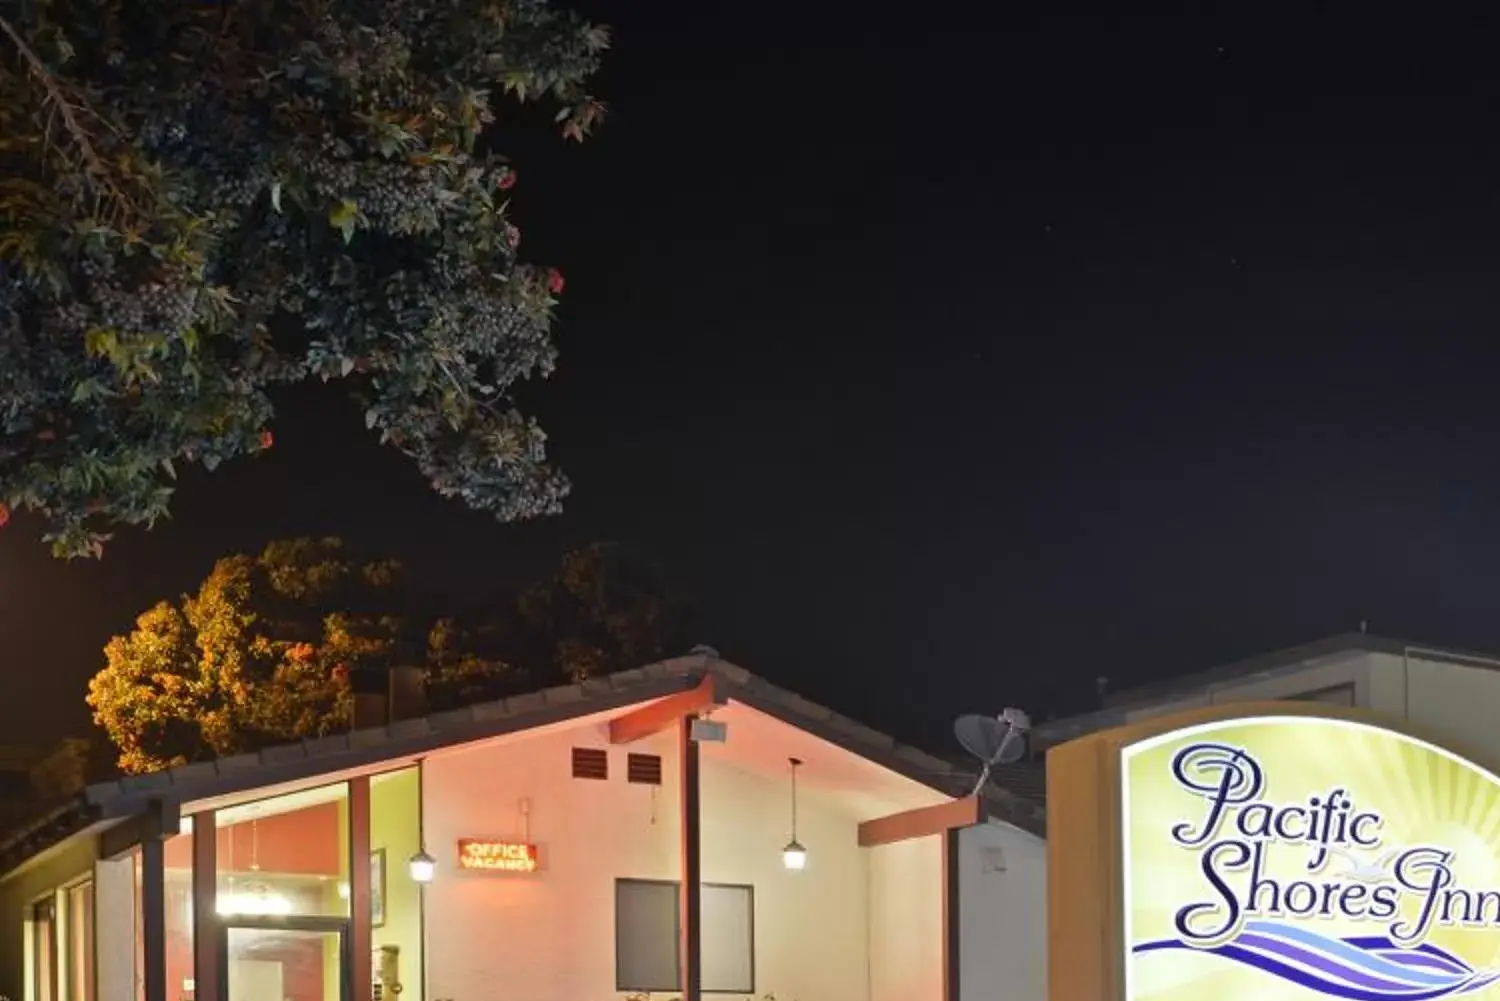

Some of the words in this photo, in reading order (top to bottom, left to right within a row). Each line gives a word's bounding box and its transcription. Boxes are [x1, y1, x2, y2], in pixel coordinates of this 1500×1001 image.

[1171, 743, 1380, 870] Pacific
[460, 855, 536, 872] VACANCY
[466, 843, 528, 858] OFFICE
[1174, 839, 1397, 939] Shores
